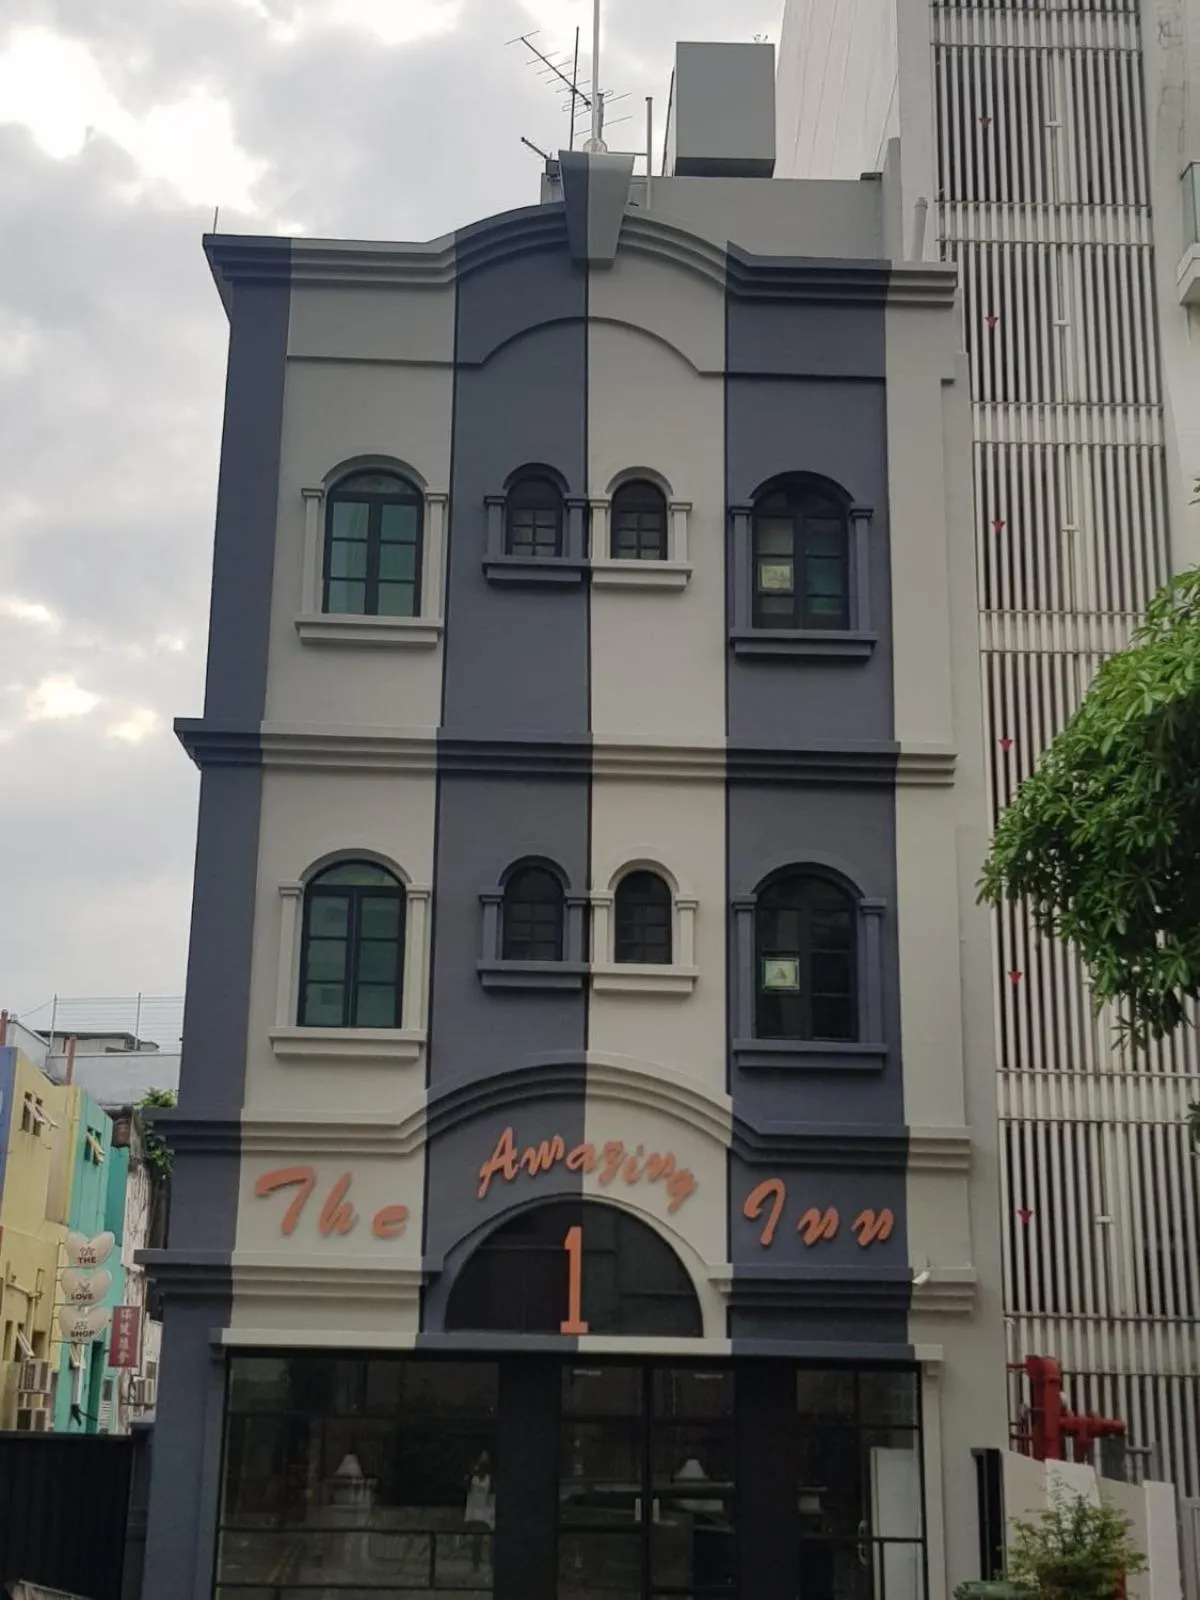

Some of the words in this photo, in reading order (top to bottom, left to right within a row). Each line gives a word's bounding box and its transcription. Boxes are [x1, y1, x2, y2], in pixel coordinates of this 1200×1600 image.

[255, 1165, 409, 1239] The
[478, 1126, 697, 1213] Amazing
[743, 1177, 895, 1247] Inn
[77, 1256, 97, 1264] THE
[560, 1225, 590, 1336] 1
[71, 1293, 94, 1301] LOVE
[70, 1330, 95, 1338] SHOP
